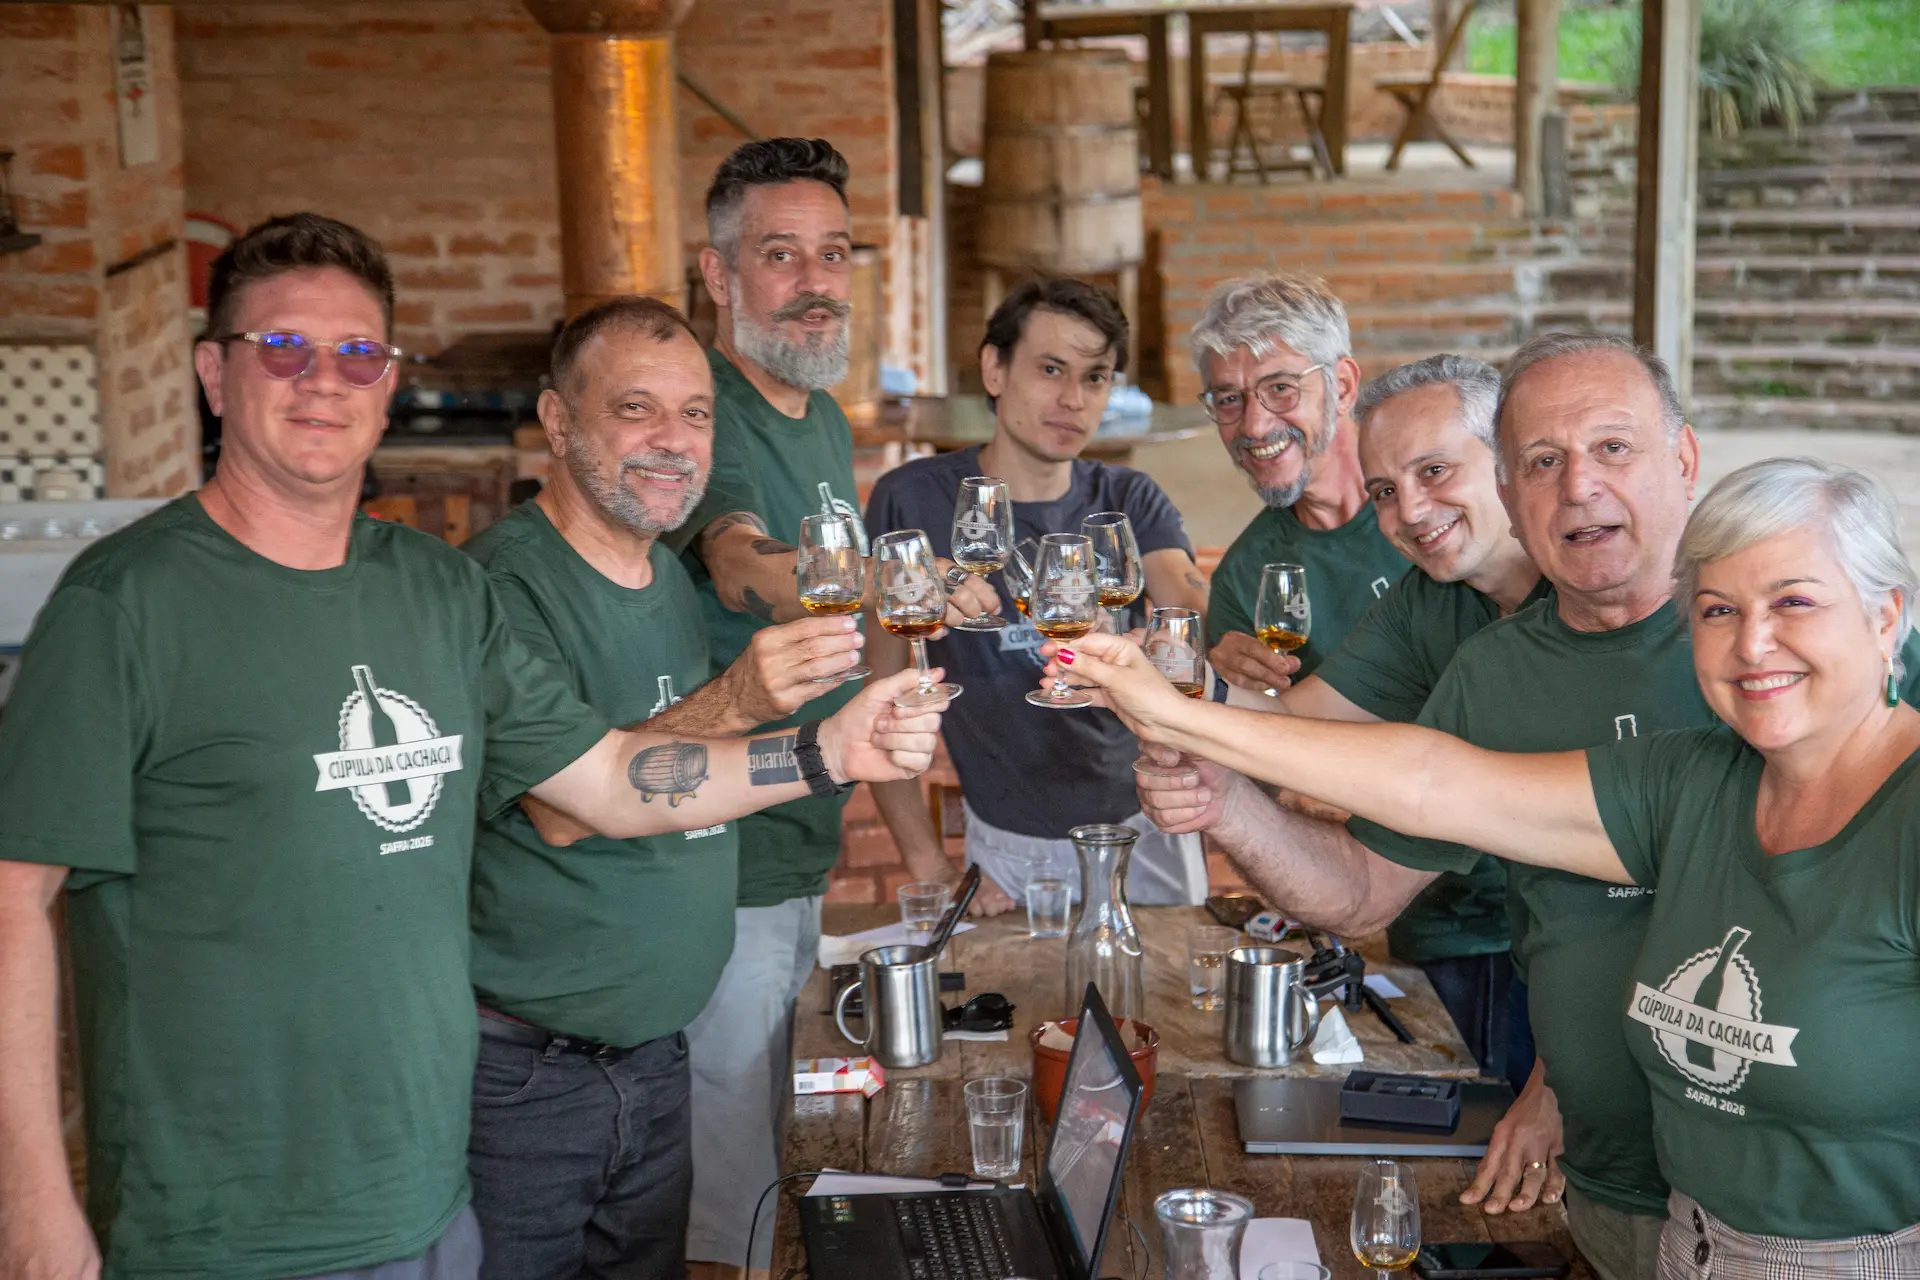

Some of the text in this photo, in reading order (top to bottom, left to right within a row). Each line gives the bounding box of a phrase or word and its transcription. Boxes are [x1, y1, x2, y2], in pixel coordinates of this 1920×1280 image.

[328, 746, 451, 779] CÚPULA DA CACHAÇA
[380, 835, 434, 855] SAFRA 2026
[1608, 886, 1645, 898] SAFRA
[1638, 994, 1774, 1057] CÚPULA DA CACHAÇA
[1684, 1087, 1745, 1116] SAFRA 2026
